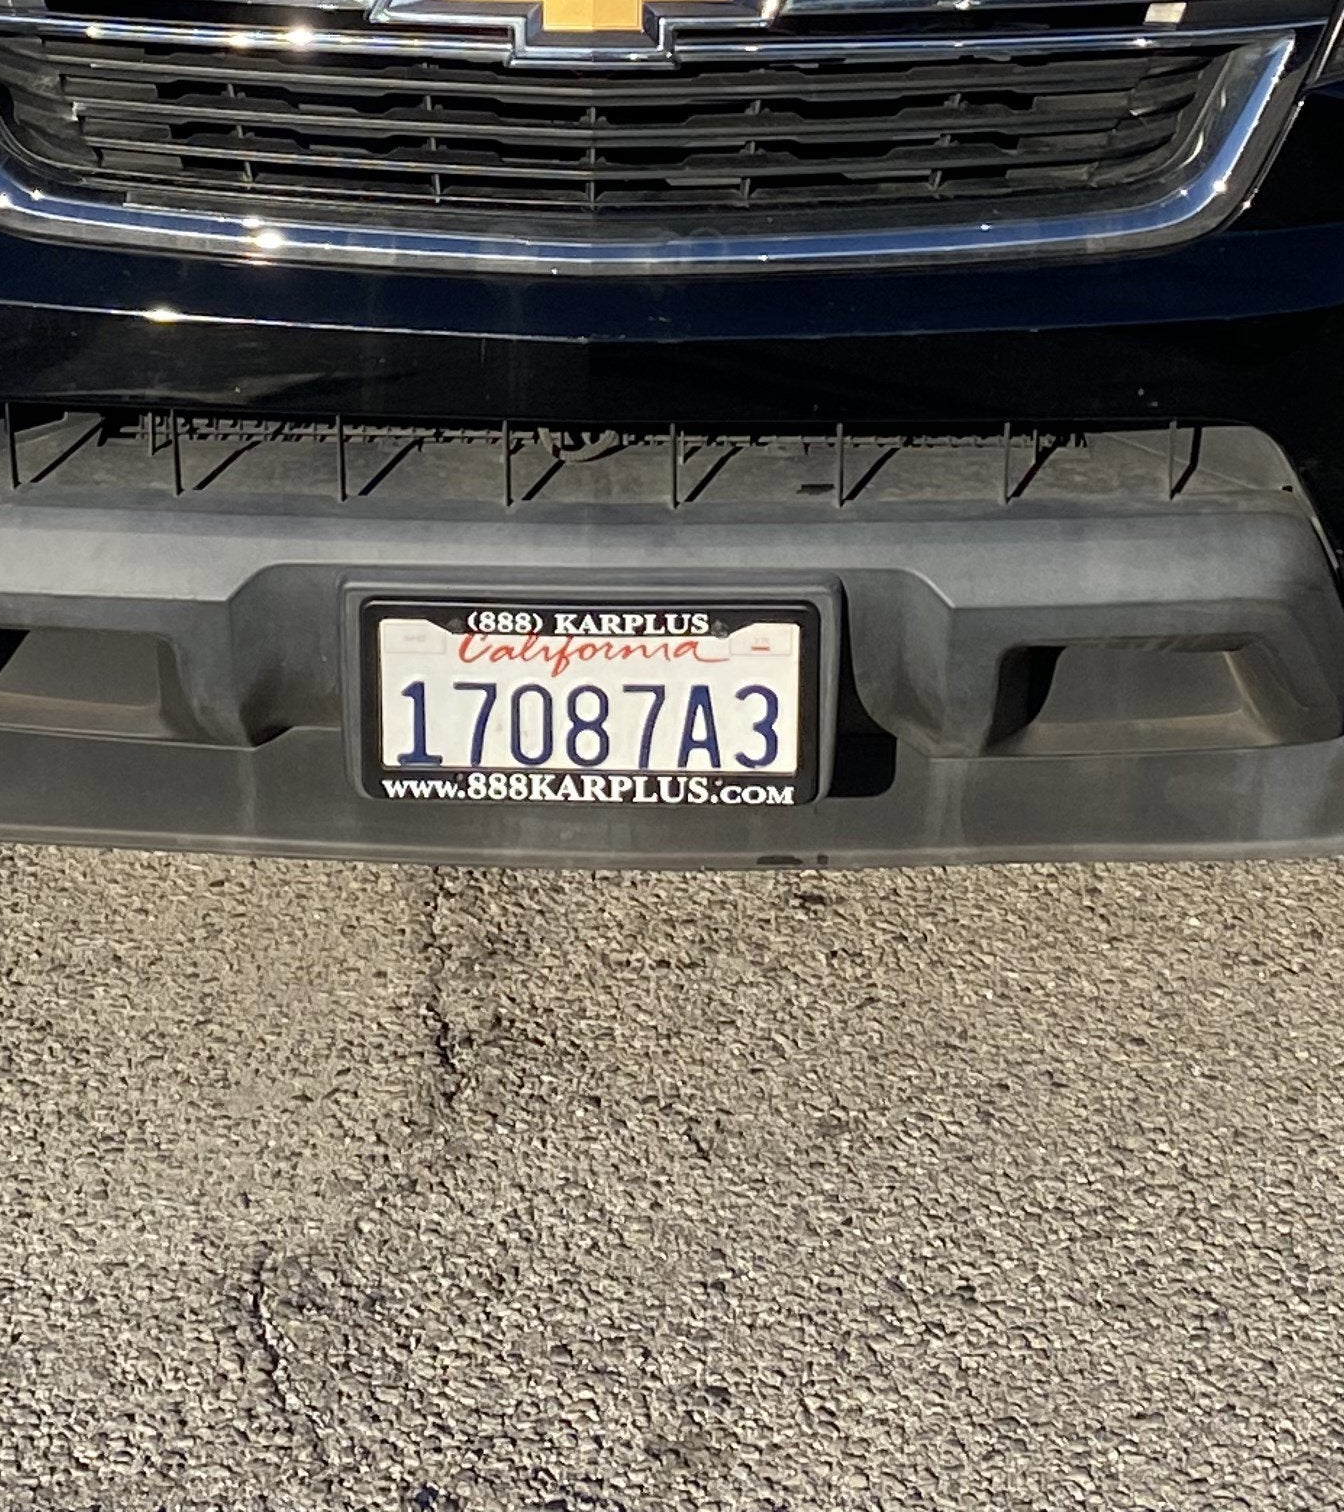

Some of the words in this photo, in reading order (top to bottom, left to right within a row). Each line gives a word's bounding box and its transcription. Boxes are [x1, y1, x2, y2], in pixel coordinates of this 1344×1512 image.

[466, 611, 544, 635] (888)
[554, 612, 710, 636] KARPLUS
[458, 632, 729, 678] California
[396, 680, 780, 770] 17087A3
